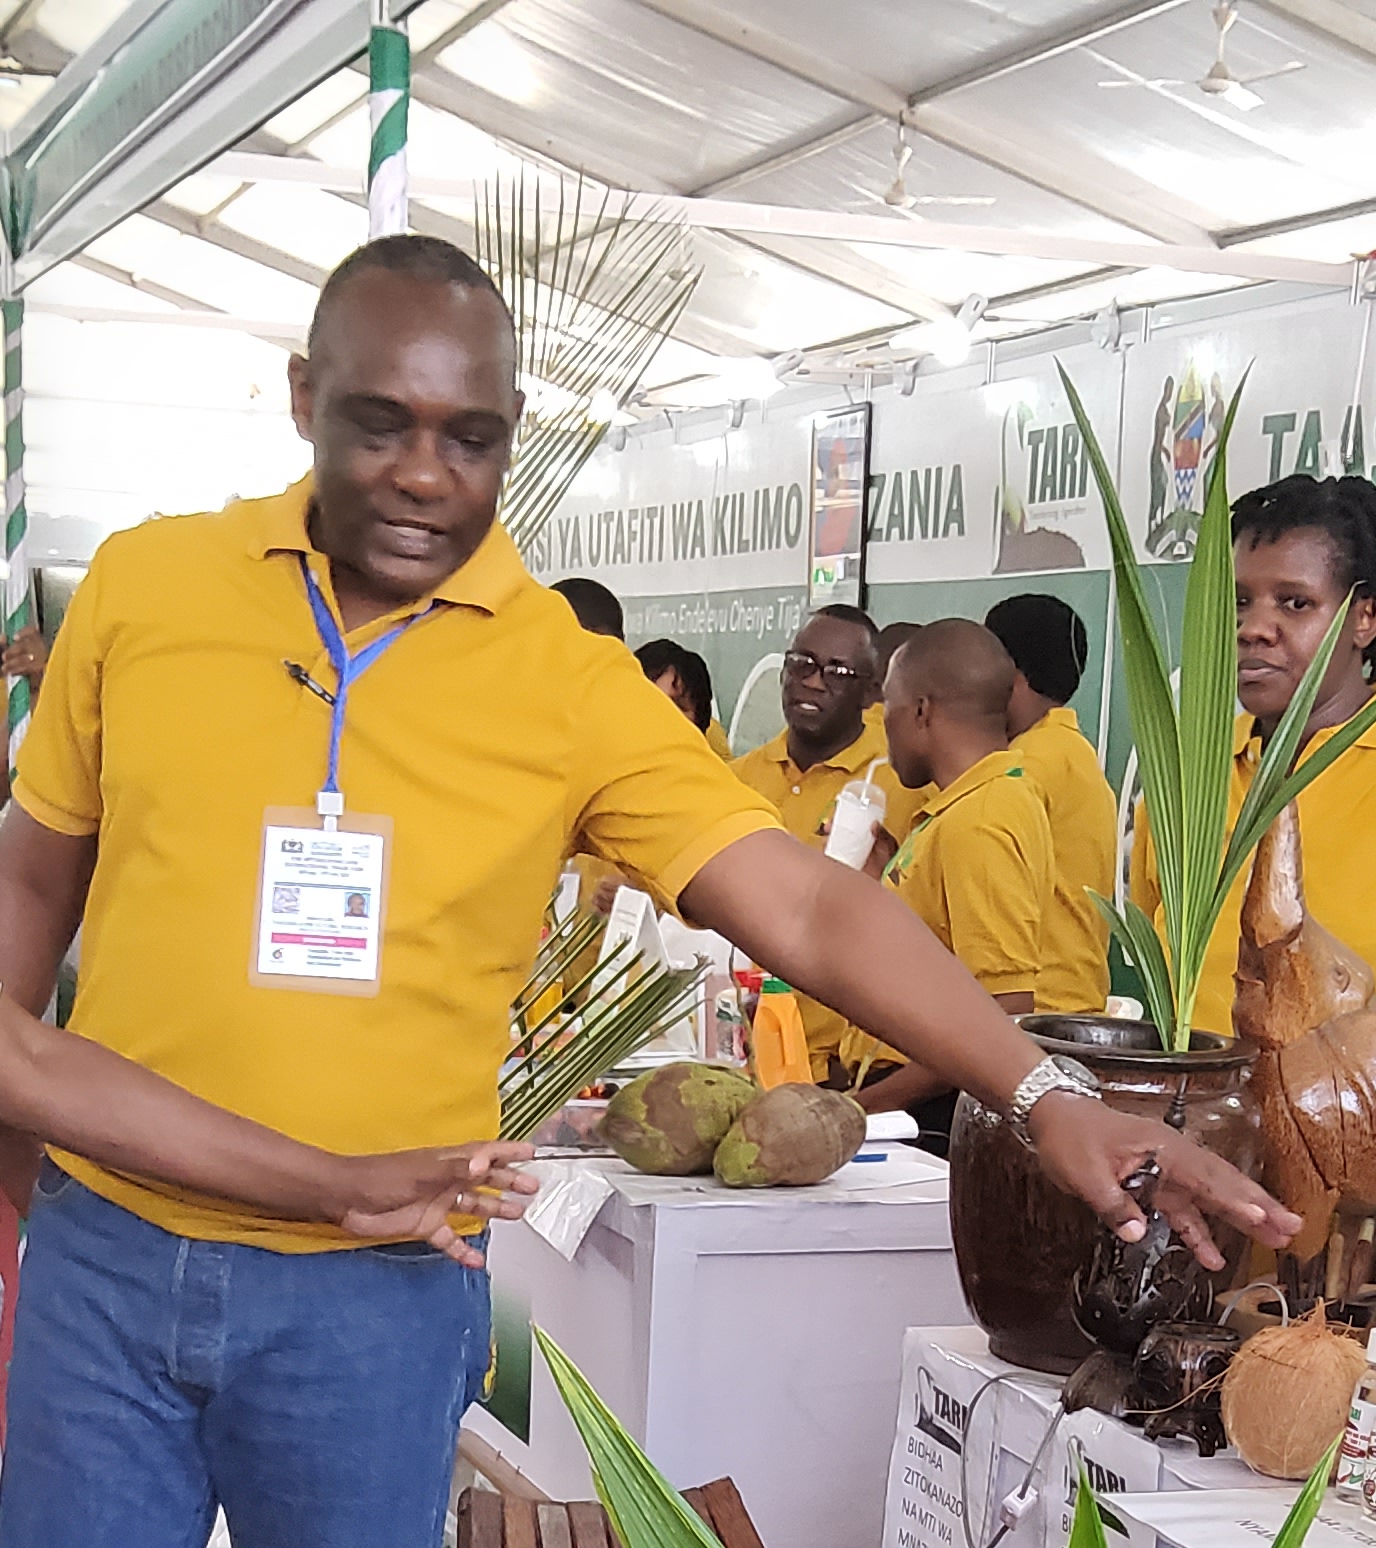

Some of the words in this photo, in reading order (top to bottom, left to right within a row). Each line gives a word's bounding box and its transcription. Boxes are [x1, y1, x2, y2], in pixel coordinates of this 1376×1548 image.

[558, 515, 583, 570] YA
[588, 505, 665, 568] UTAFITI
[672, 498, 707, 561] WA
[712, 483, 803, 557] KILIMO
[868, 464, 966, 541] ZANIA
[901, 1497, 918, 1519] NA
[938, 1518, 953, 1546] WA
